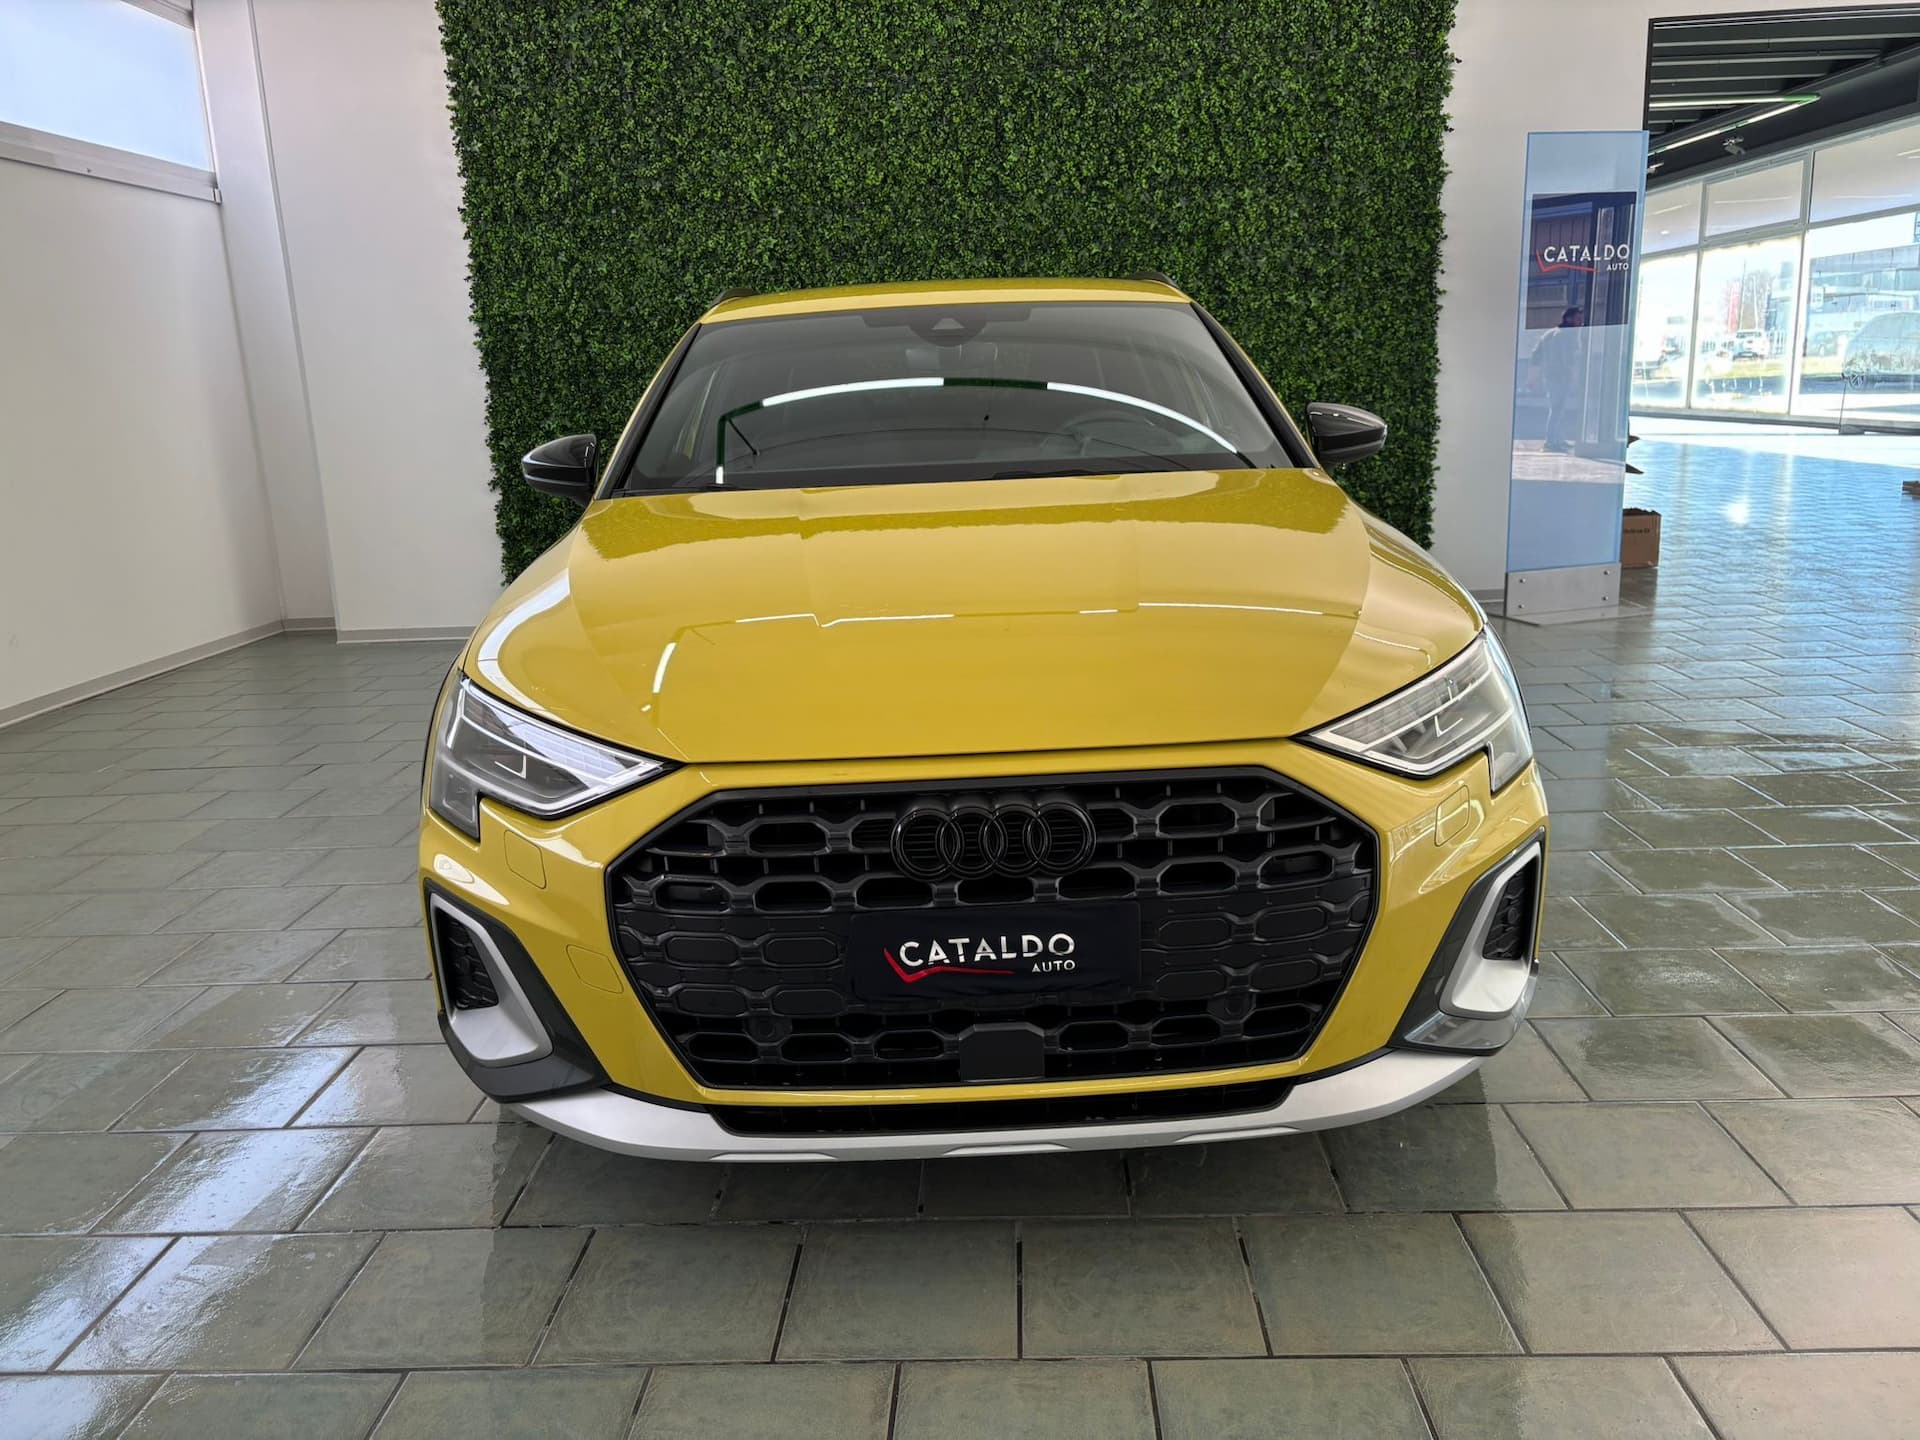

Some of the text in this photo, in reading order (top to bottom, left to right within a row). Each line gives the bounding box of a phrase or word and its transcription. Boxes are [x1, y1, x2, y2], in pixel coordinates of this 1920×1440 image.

[1543, 244, 1630, 263] CATALDO
[1606, 262, 1629, 271] AUTO
[900, 932, 1075, 967] CATALDO
[1031, 960, 1075, 973] AUTO
